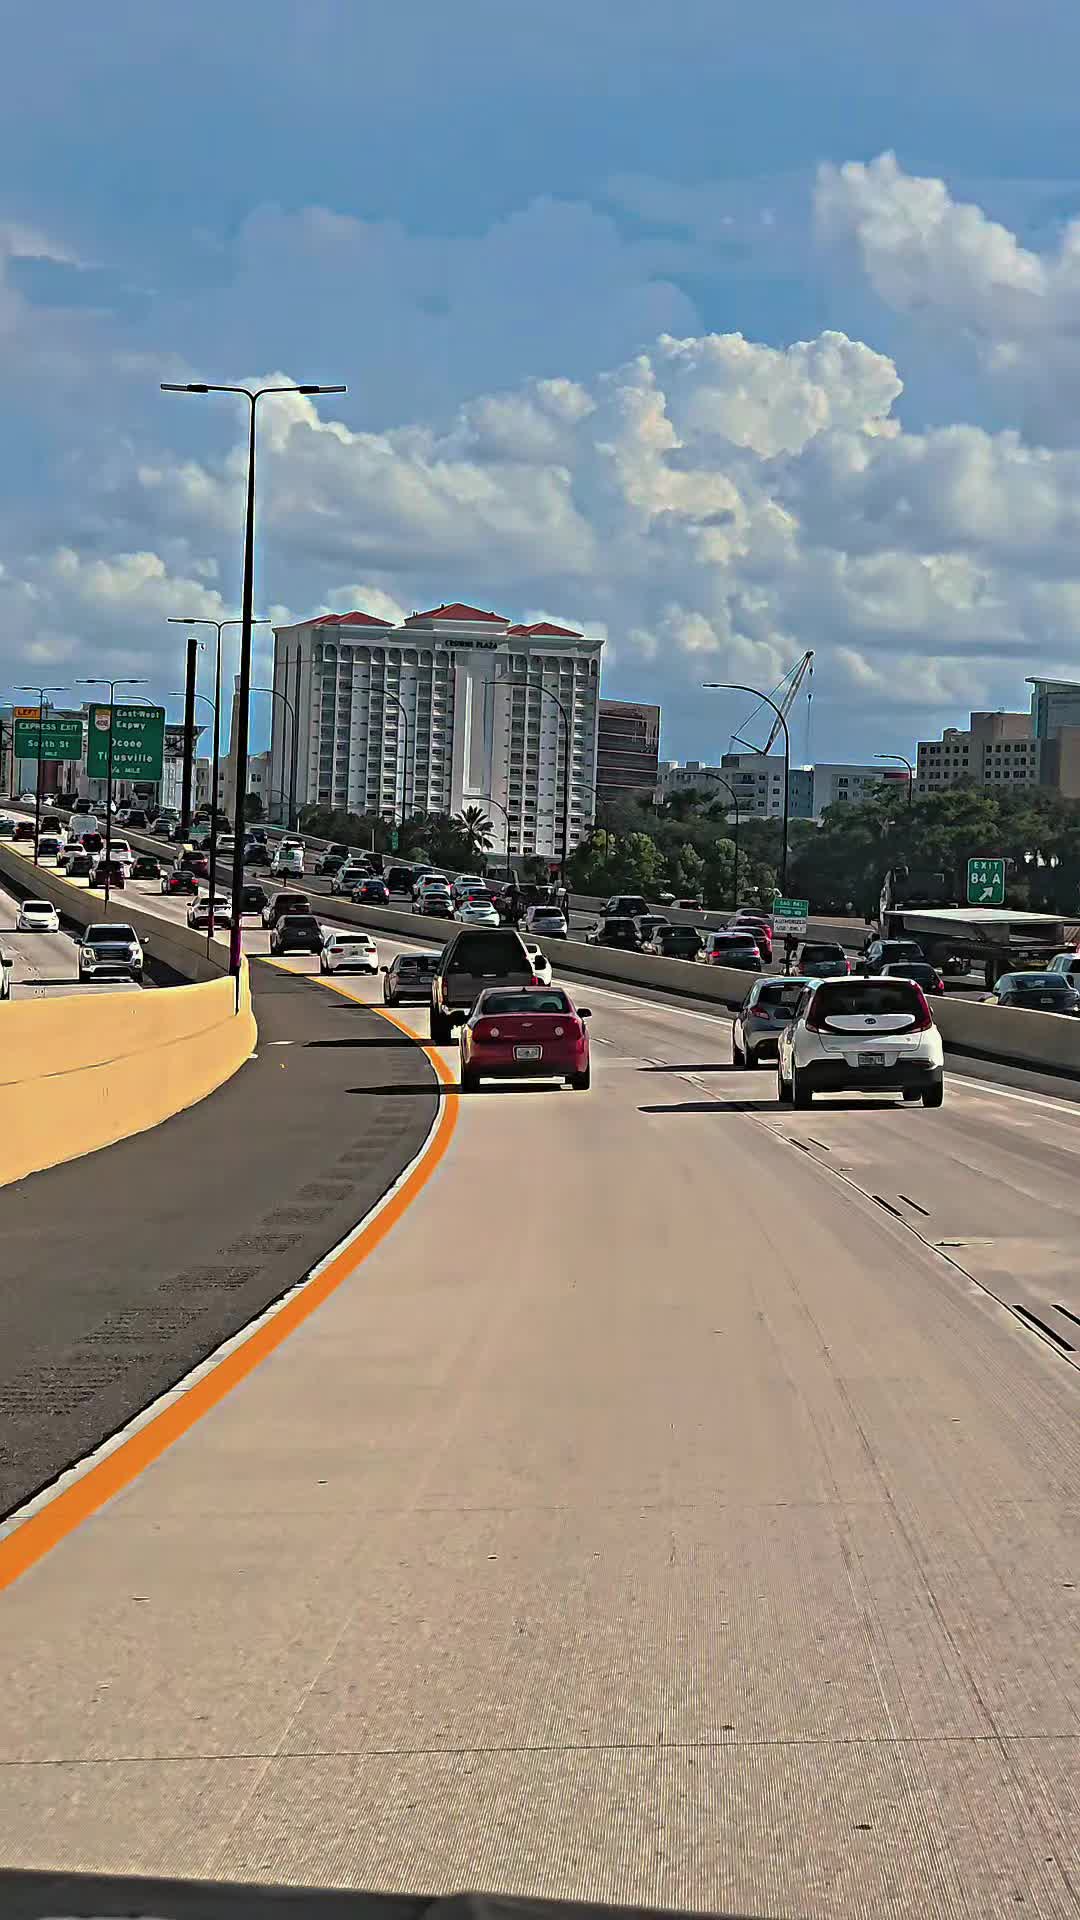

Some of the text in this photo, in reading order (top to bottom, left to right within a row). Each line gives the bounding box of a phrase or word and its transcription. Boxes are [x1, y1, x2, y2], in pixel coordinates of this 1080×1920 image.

[476, 641, 498, 649] PLAZA
[16, 709, 38, 717] LEFT
[116, 709, 160, 719] East-West
[19, 722, 57, 731] EXPRESS
[116, 721, 146, 731] Expwy
[59, 740, 69, 748] St
[98, 751, 153, 763] Tiusville
[974, 861, 999, 869] EXIT
[971, 872, 1001, 884] 84 A
